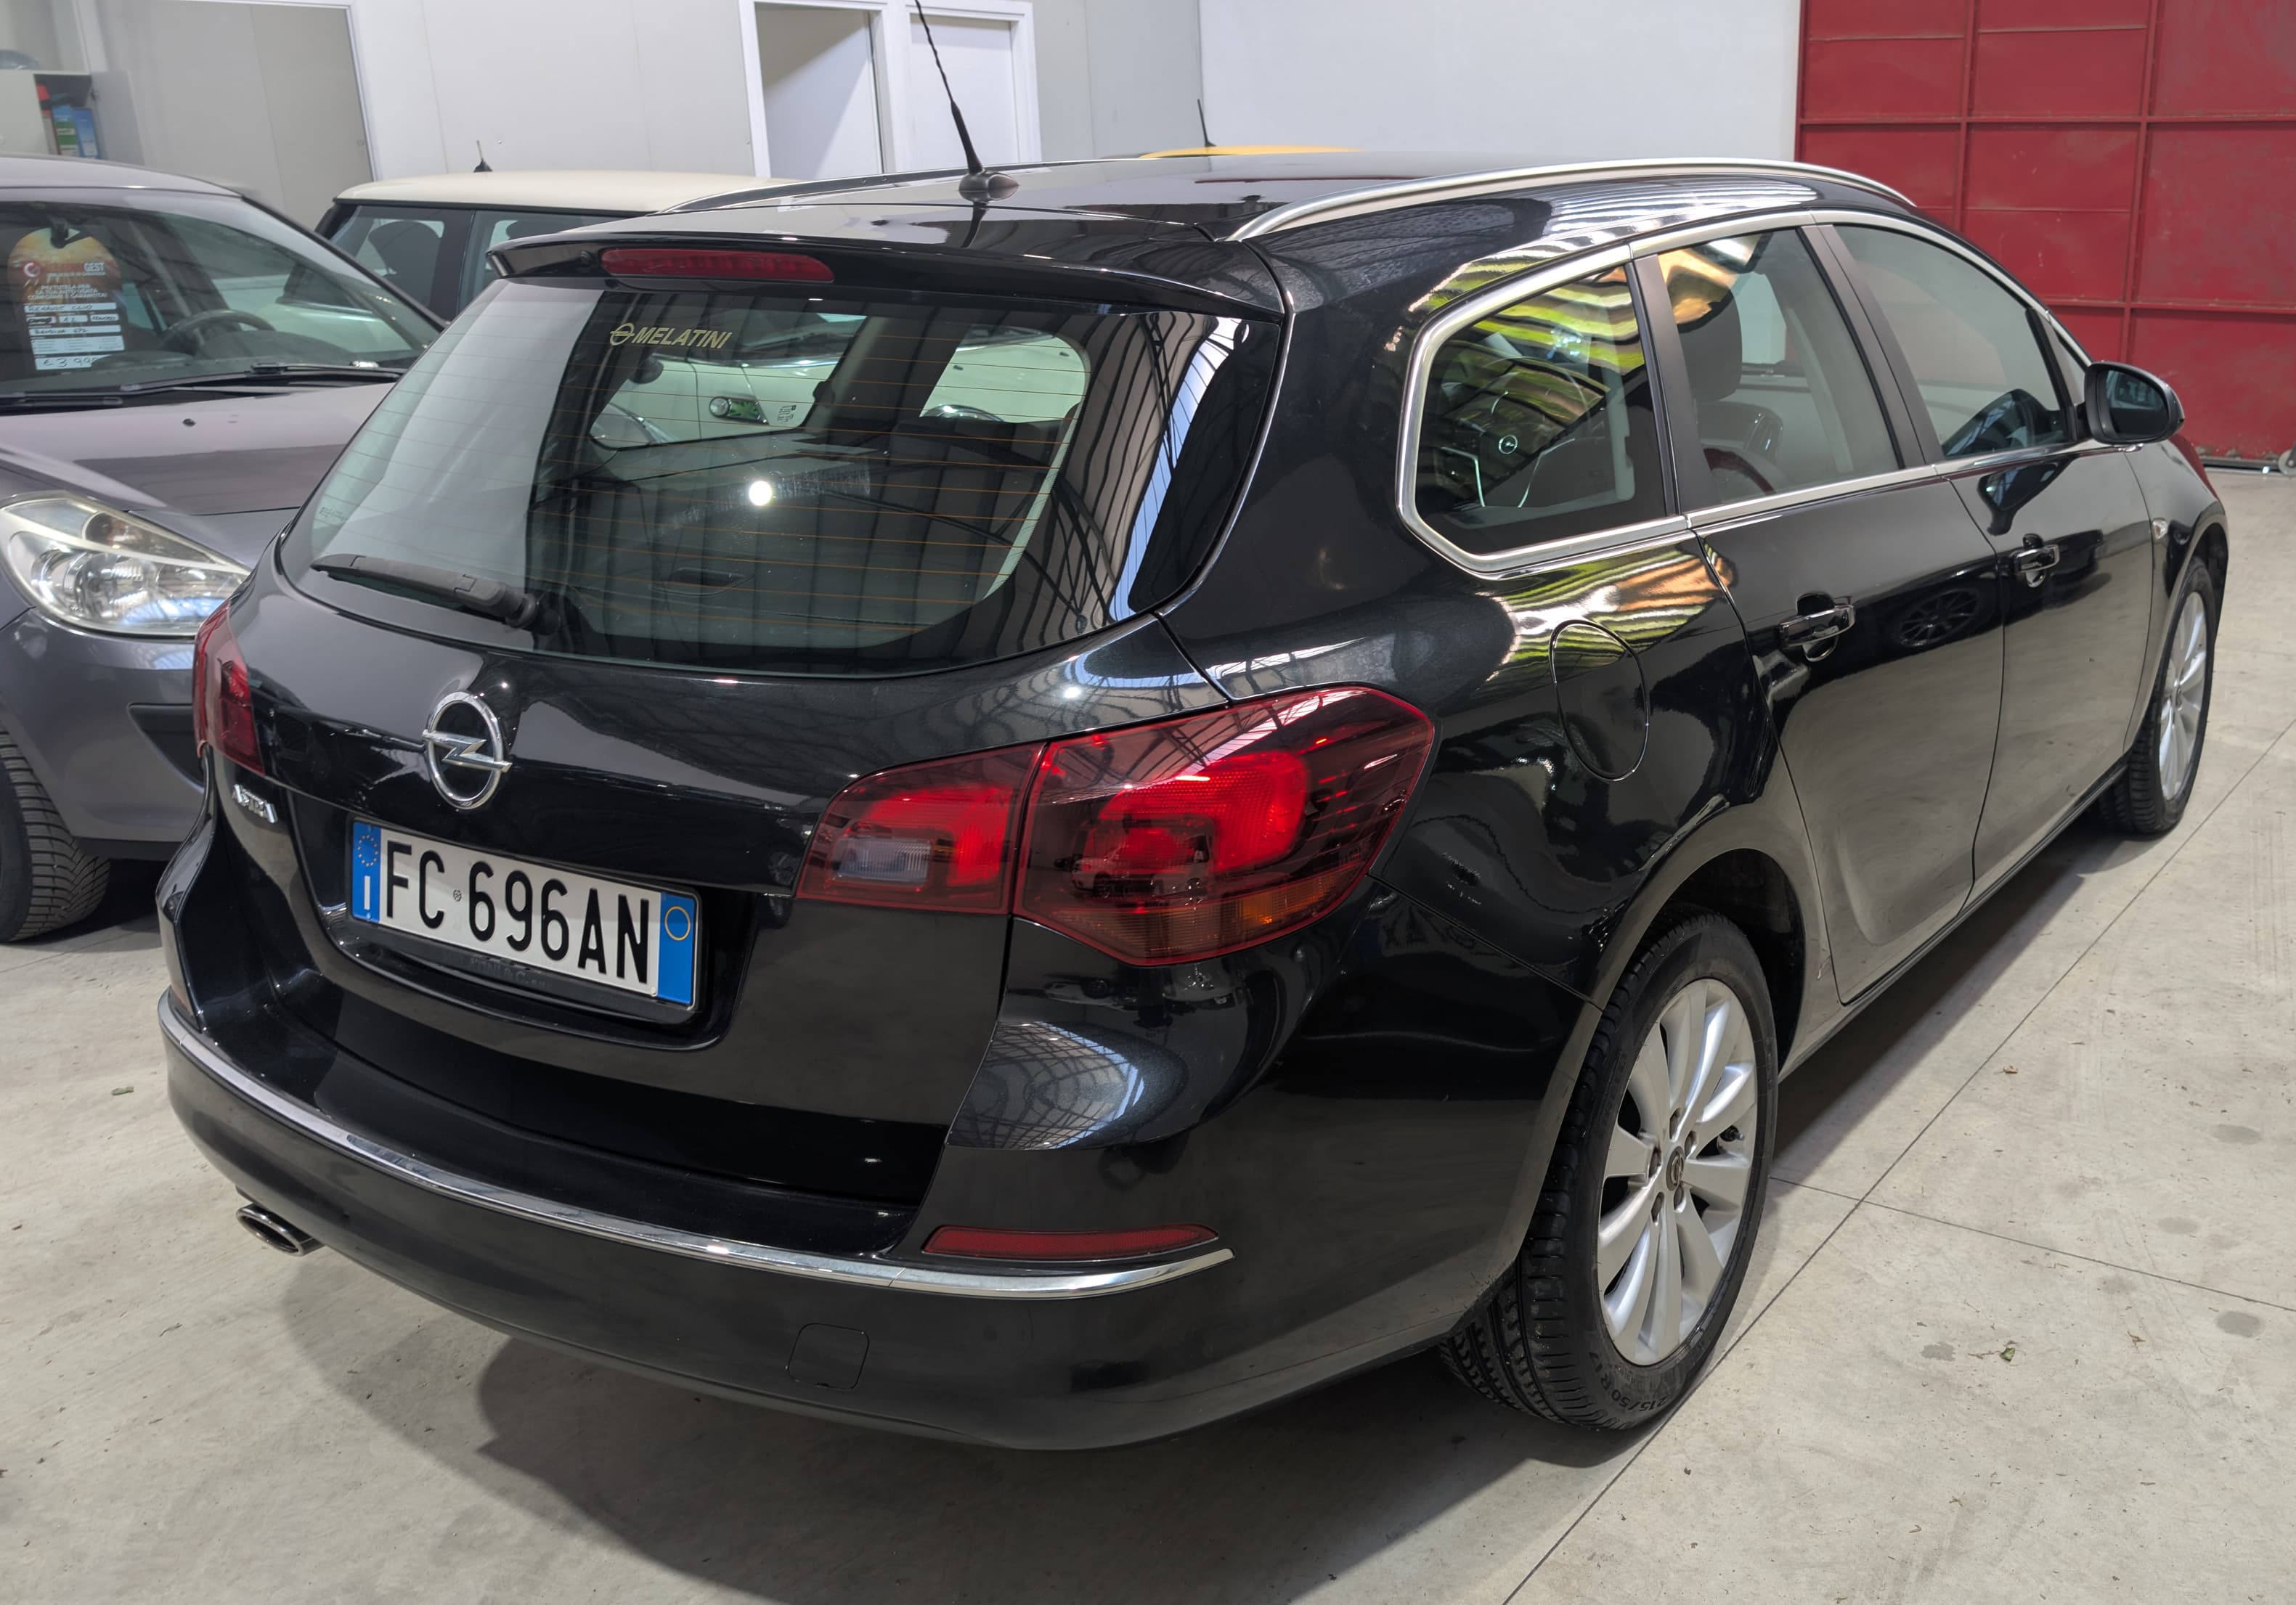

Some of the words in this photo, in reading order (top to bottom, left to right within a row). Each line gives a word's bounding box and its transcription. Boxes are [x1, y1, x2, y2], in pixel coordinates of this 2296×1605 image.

[631, 326, 733, 349] MELATINI
[232, 783, 278, 823] ASTRA
[386, 839, 445, 930] FC
[468, 860, 650, 984] 696AN
